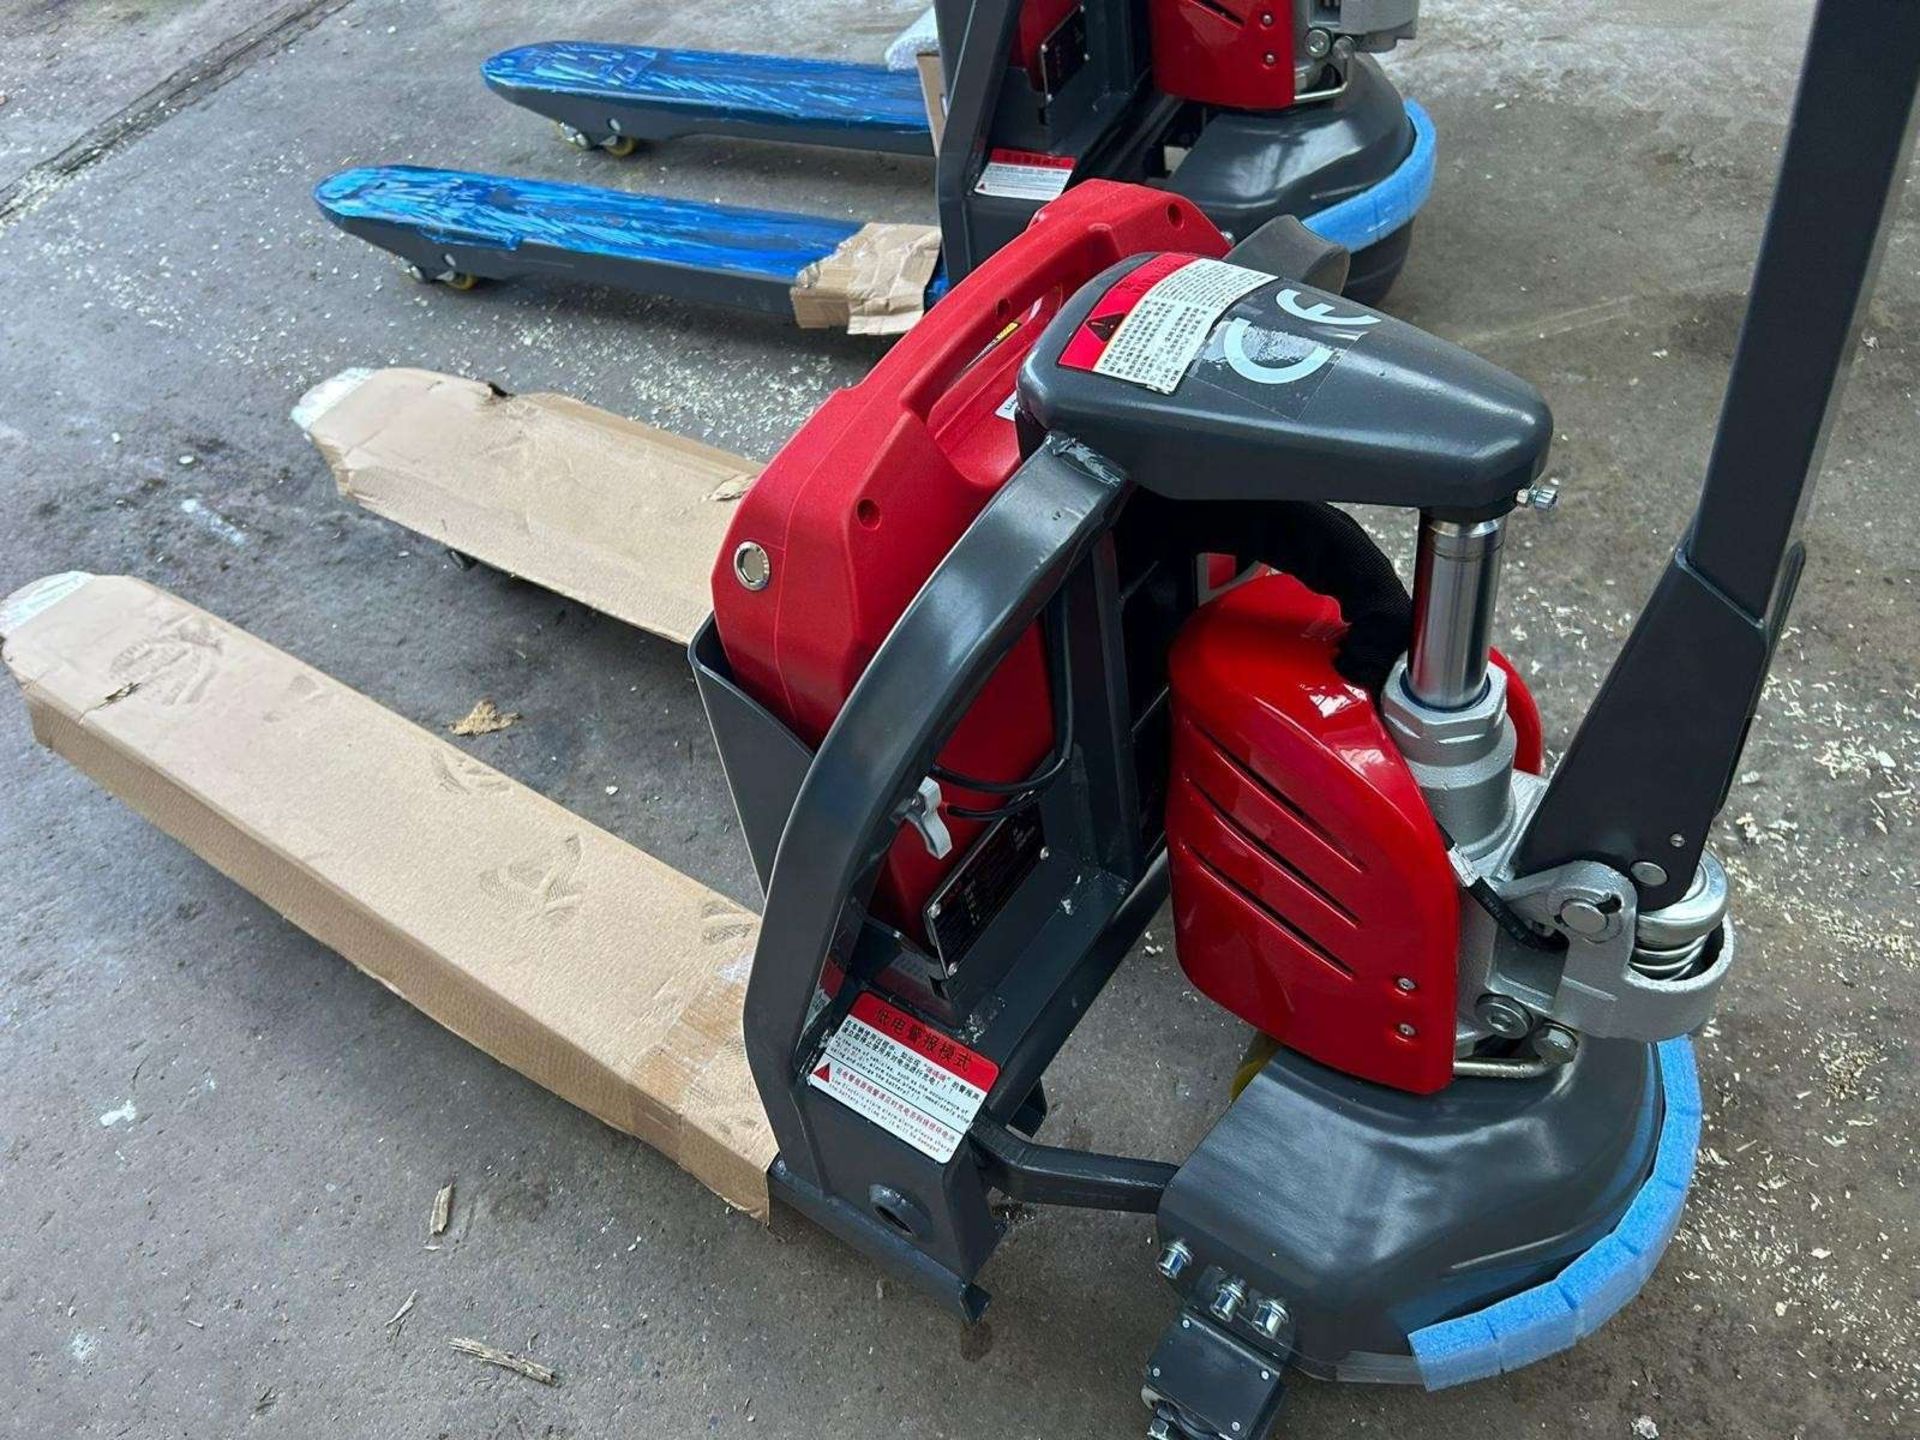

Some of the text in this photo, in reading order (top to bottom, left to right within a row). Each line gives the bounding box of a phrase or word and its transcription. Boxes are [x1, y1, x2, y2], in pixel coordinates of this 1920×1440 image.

[1223, 288, 1382, 385] CE
[873, 1008, 974, 1071] 低电警报模式
